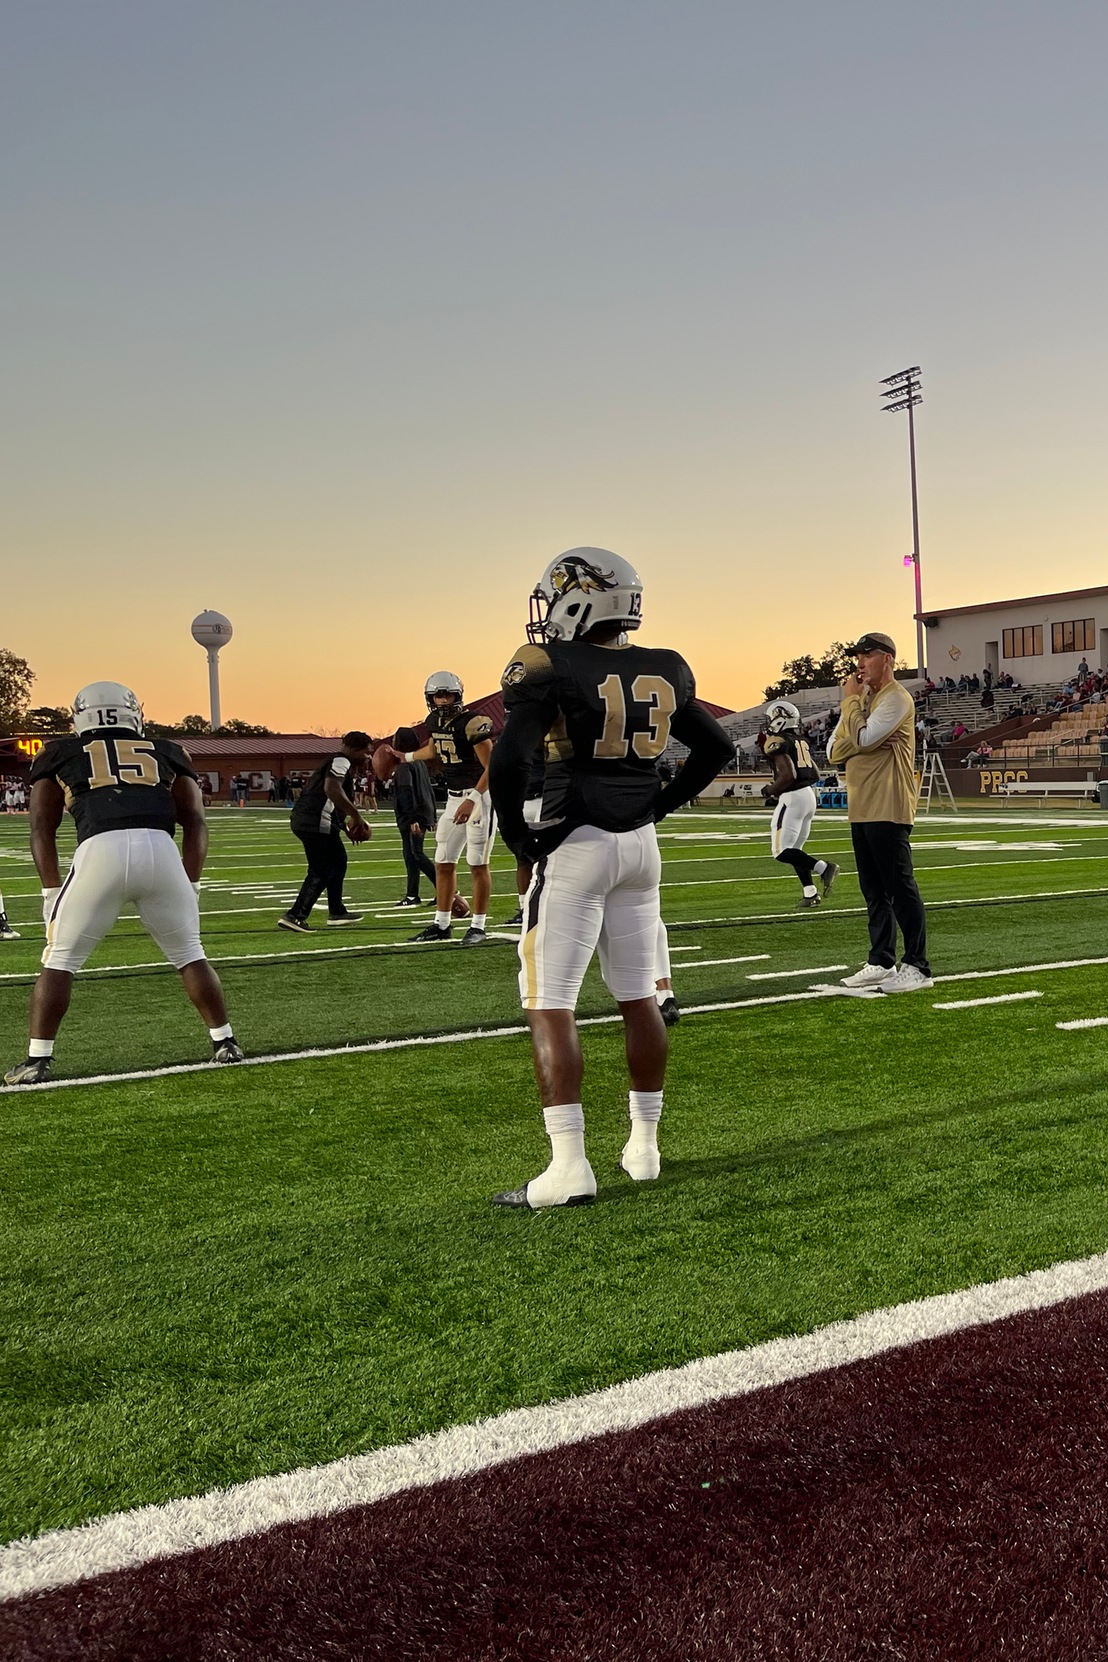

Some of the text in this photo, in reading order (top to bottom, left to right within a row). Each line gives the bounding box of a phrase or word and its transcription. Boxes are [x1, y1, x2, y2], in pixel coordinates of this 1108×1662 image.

[97, 708, 118, 726] 15
[592, 674, 677, 759] 13
[18, 739, 43, 756] 40
[82, 739, 160, 789] 15
[980, 771, 1028, 793] PRCC
